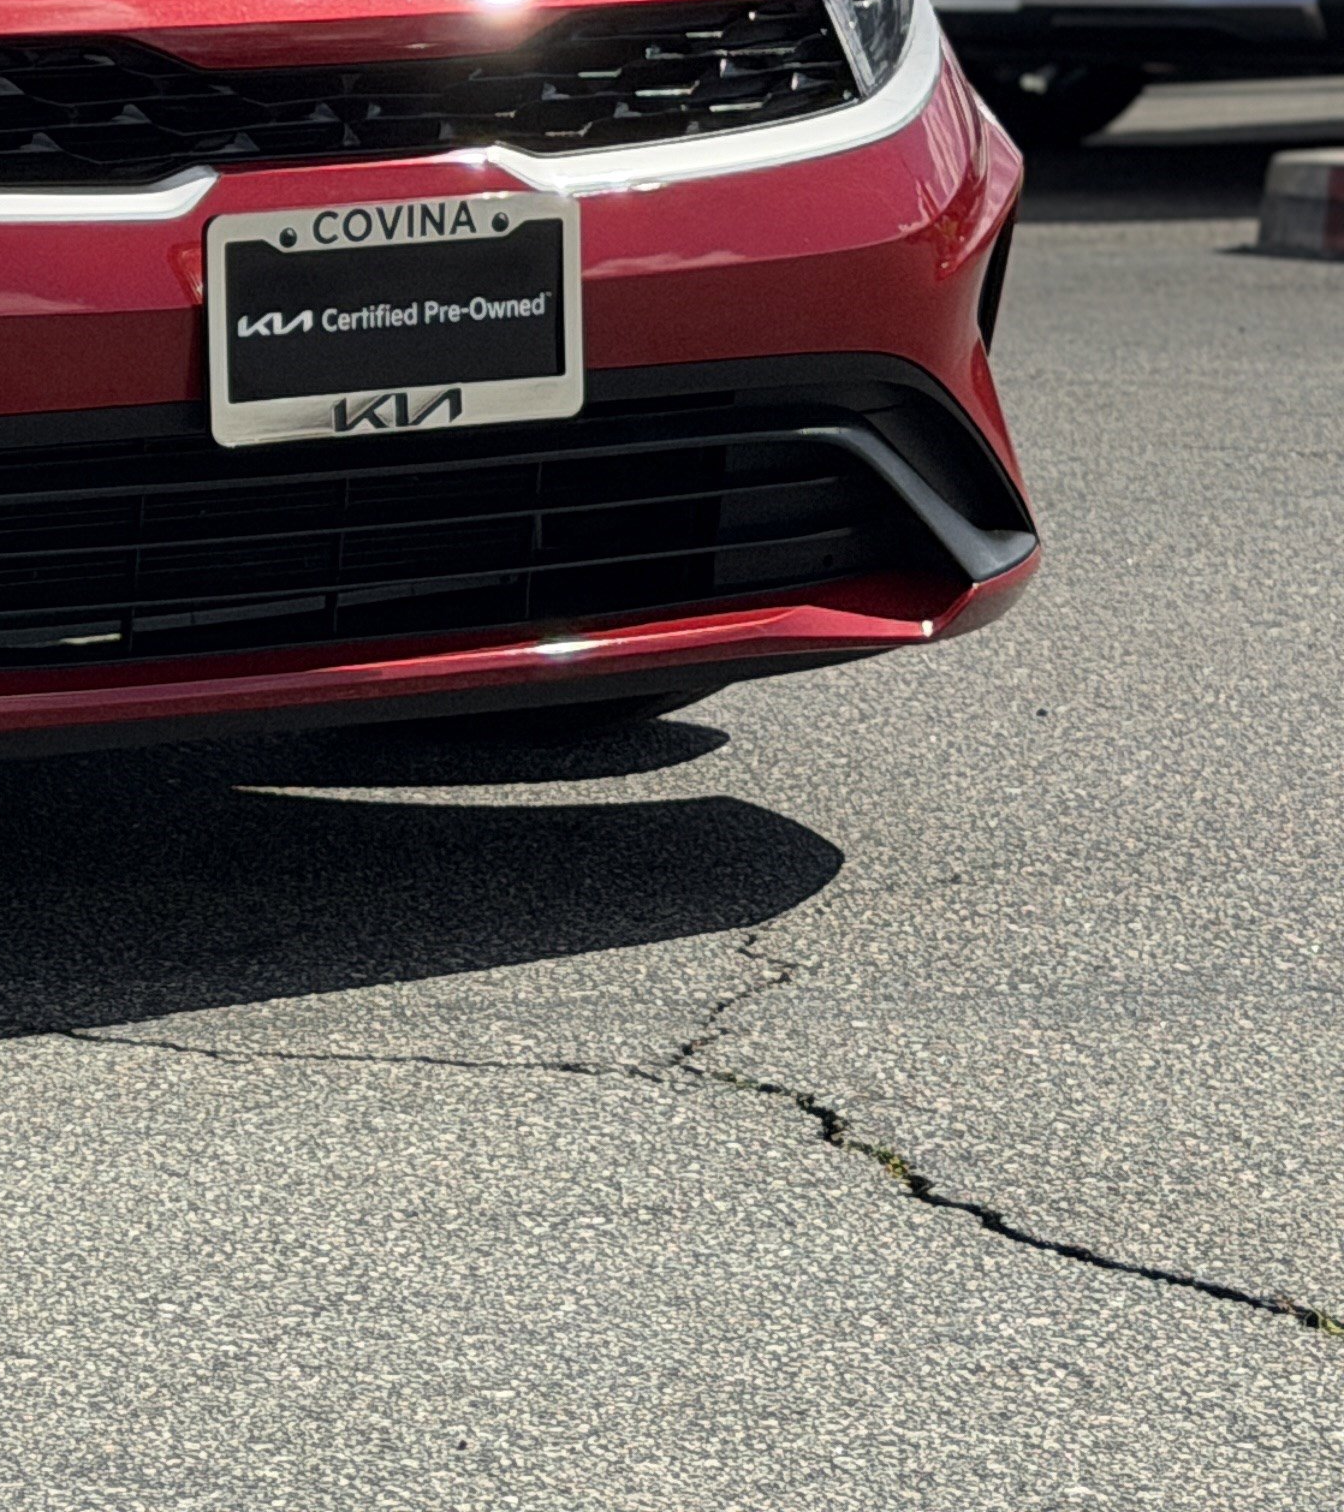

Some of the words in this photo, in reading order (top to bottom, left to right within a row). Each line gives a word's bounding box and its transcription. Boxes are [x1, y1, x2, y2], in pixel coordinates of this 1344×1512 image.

[313, 201, 477, 245] COVINA
[237, 309, 313, 338] KIA
[321, 301, 418, 333] Certified
[424, 291, 547, 324] Pre-Owned
[334, 388, 463, 433] KIA
